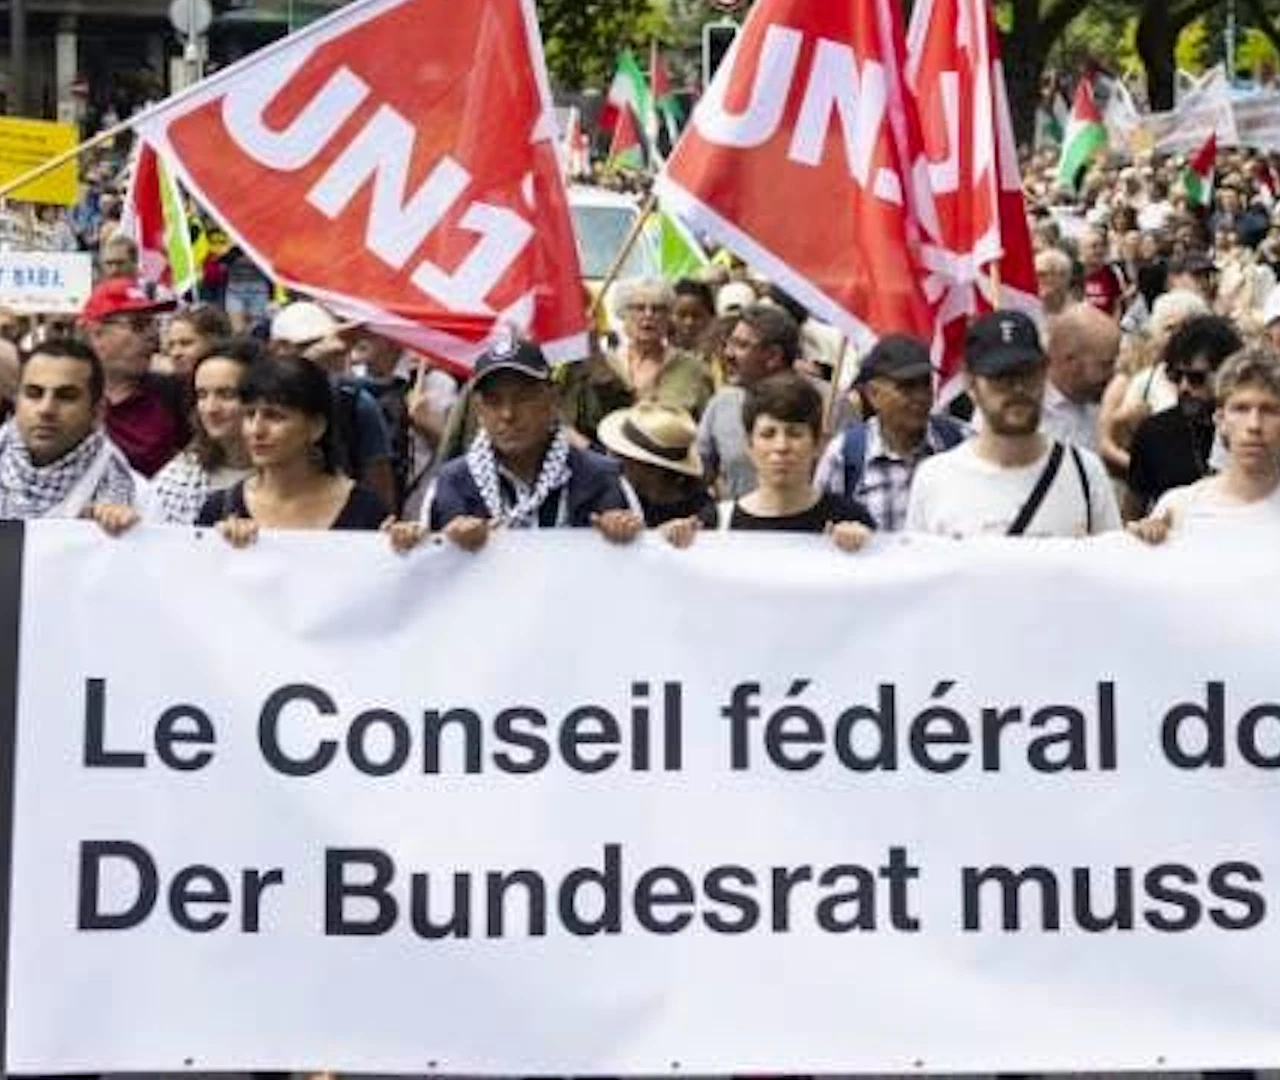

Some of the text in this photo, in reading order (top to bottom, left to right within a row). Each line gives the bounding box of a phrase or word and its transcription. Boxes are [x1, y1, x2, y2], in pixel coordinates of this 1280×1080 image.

[84, 678, 215, 771] Le
[258, 682, 682, 777] Conseil
[721, 679, 1117, 774] fédéral
[77, 840, 283, 933] Der
[325, 844, 920, 940] Bundesrat
[962, 861, 1266, 933] muss
